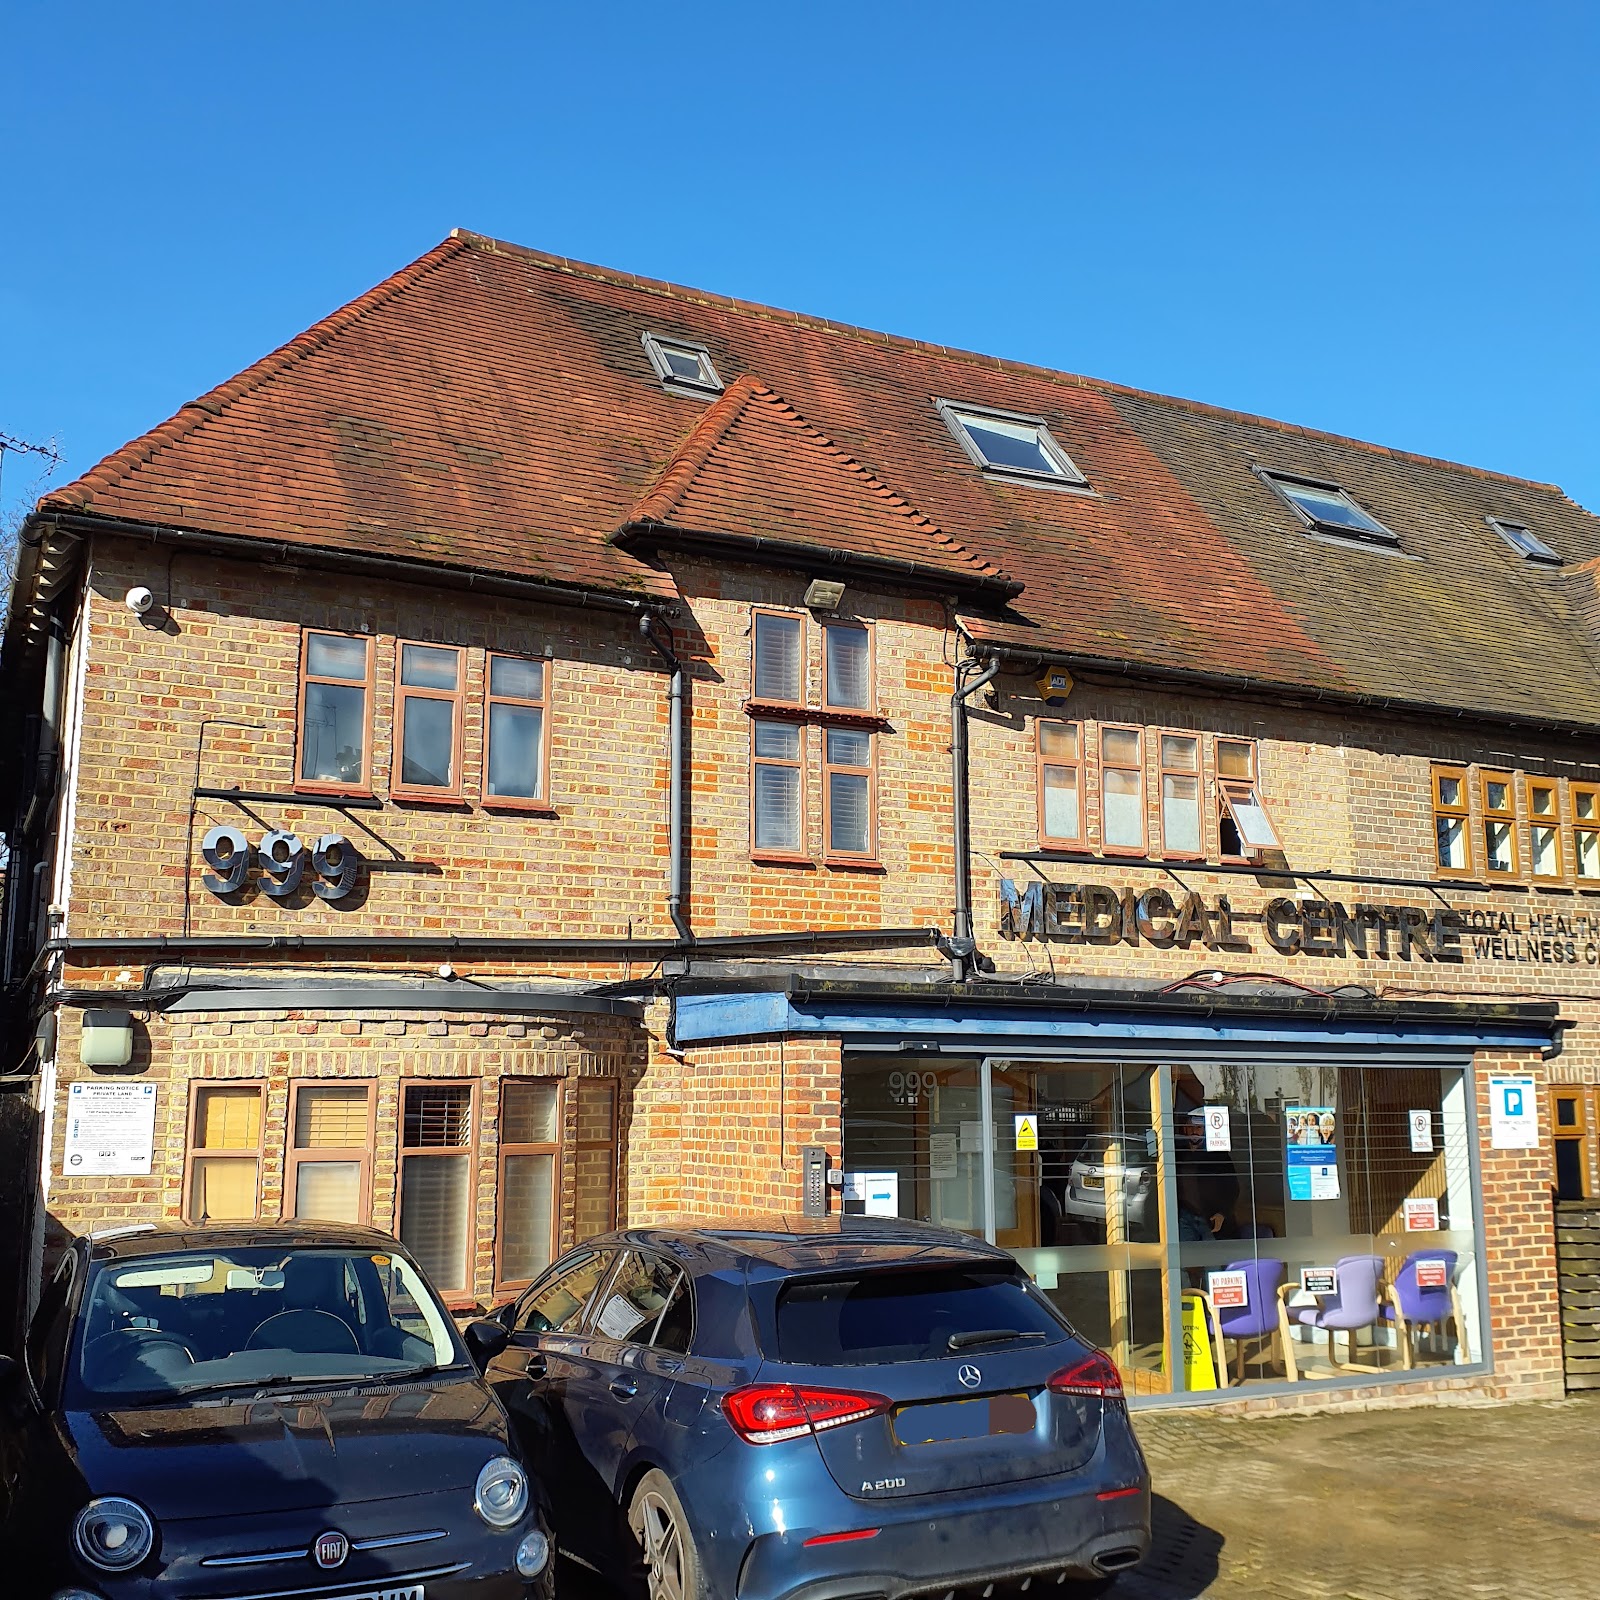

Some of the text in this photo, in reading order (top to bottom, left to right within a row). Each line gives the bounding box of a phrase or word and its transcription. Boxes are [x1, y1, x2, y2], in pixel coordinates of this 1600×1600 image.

[1052, 676, 1066, 686] ADT
[202, 825, 358, 900] 999
[999, 878, 1464, 957] MEDICAL CENTRE
[1459, 909, 1599, 939] TOTAL HEALTH
[1472, 936, 1600, 965] WELLNESS C
[889, 1071, 938, 1098] 999
[1416, 1203, 1435, 1211] PARKING
[1213, 1276, 1243, 1286] NO PARKING
[861, 1477, 907, 1492] A 200
[321, 1541, 342, 1560] FIAT
